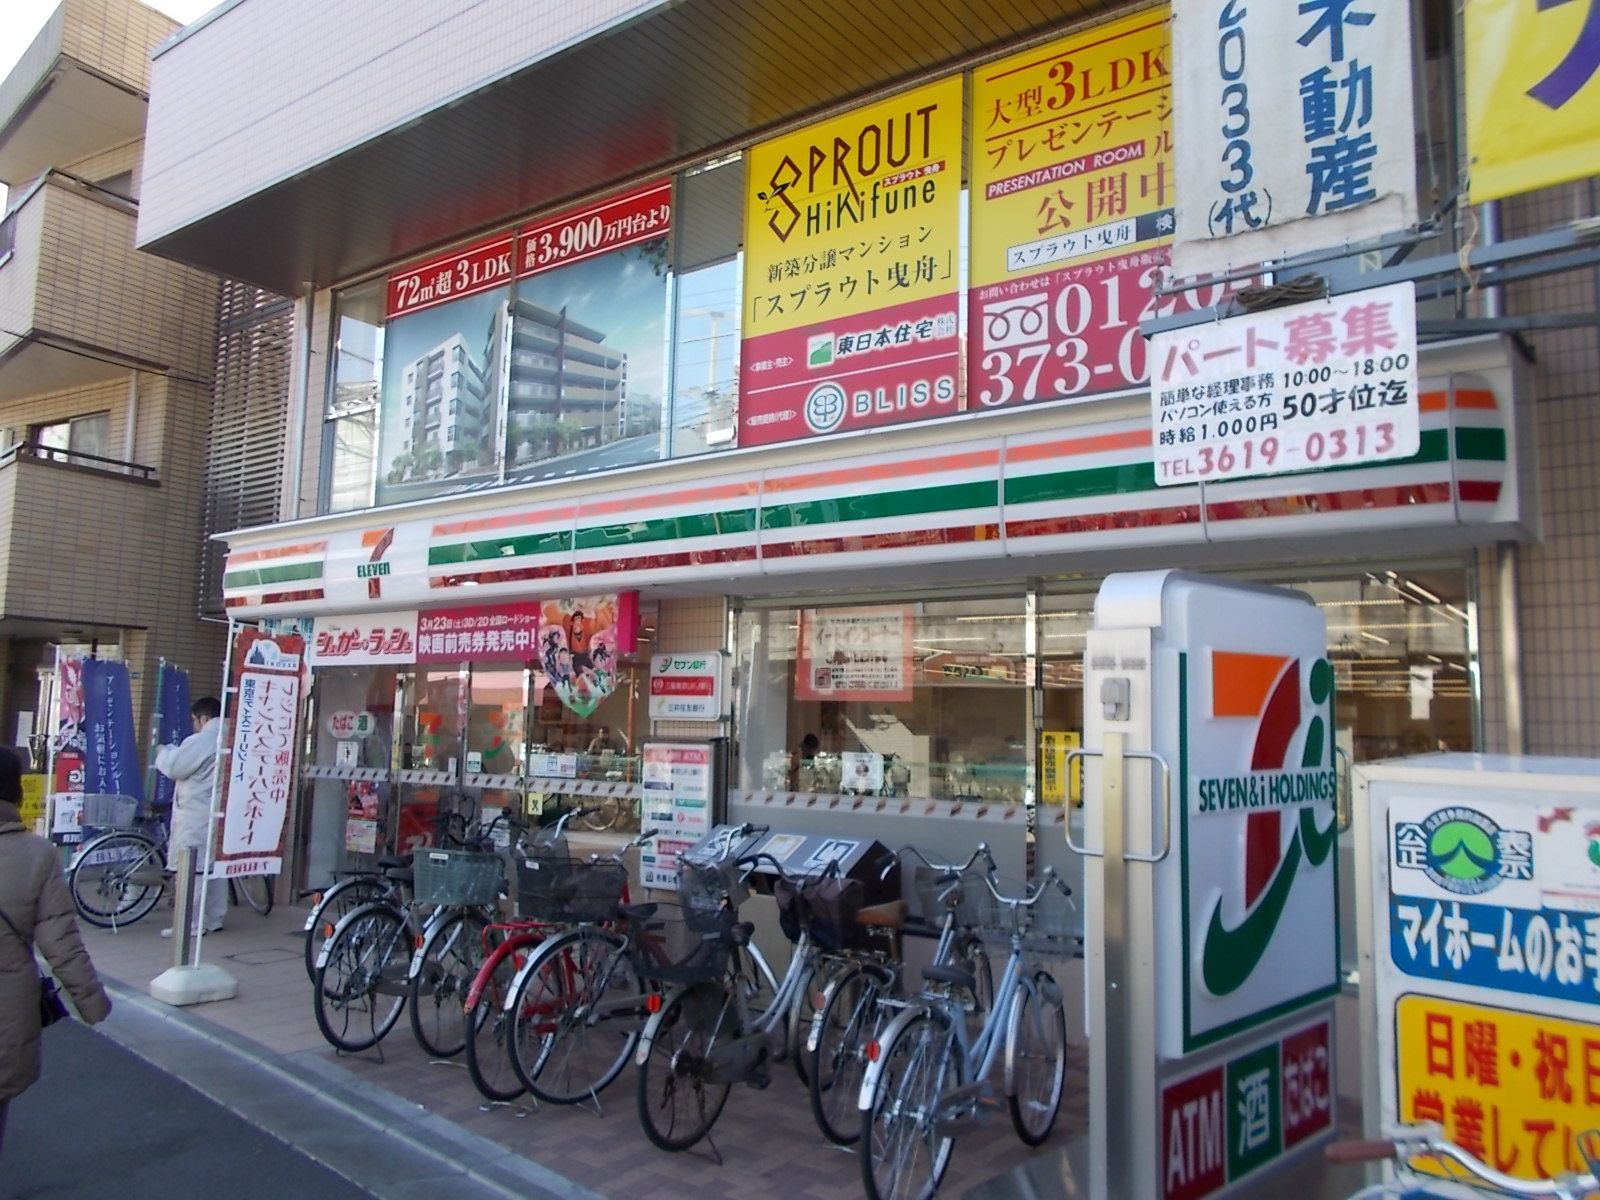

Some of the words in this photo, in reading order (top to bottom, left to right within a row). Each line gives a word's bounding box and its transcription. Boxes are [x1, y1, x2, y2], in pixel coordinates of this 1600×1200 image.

[769, 103, 938, 243] SPROUT
[988, 161, 1085, 197] PRESENTATION
[1094, 145, 1142, 167] ROOM
[768, 226, 933, 283] 新築分譲マンション
[1014, 226, 1131, 264] スプラウト曳舟
[753, 249, 951, 323] 「スプラウト曳舟」
[837, 320, 934, 355] 東日本住宅
[1161, 302, 1398, 382] パート募集
[855, 379, 952, 414] BLISS
[1160, 373, 1275, 406] 簡単な経理事務
[1160, 392, 1273, 423] パソコン使える方
[1283, 380, 1408, 421] 50才位迄
[1269, 771, 1336, 805] HOLDINGS
[1238, 1068, 1270, 1157] 酒
[1285, 1046, 1329, 1127] たばこ
[1168, 1091, 1221, 1193] ATM
